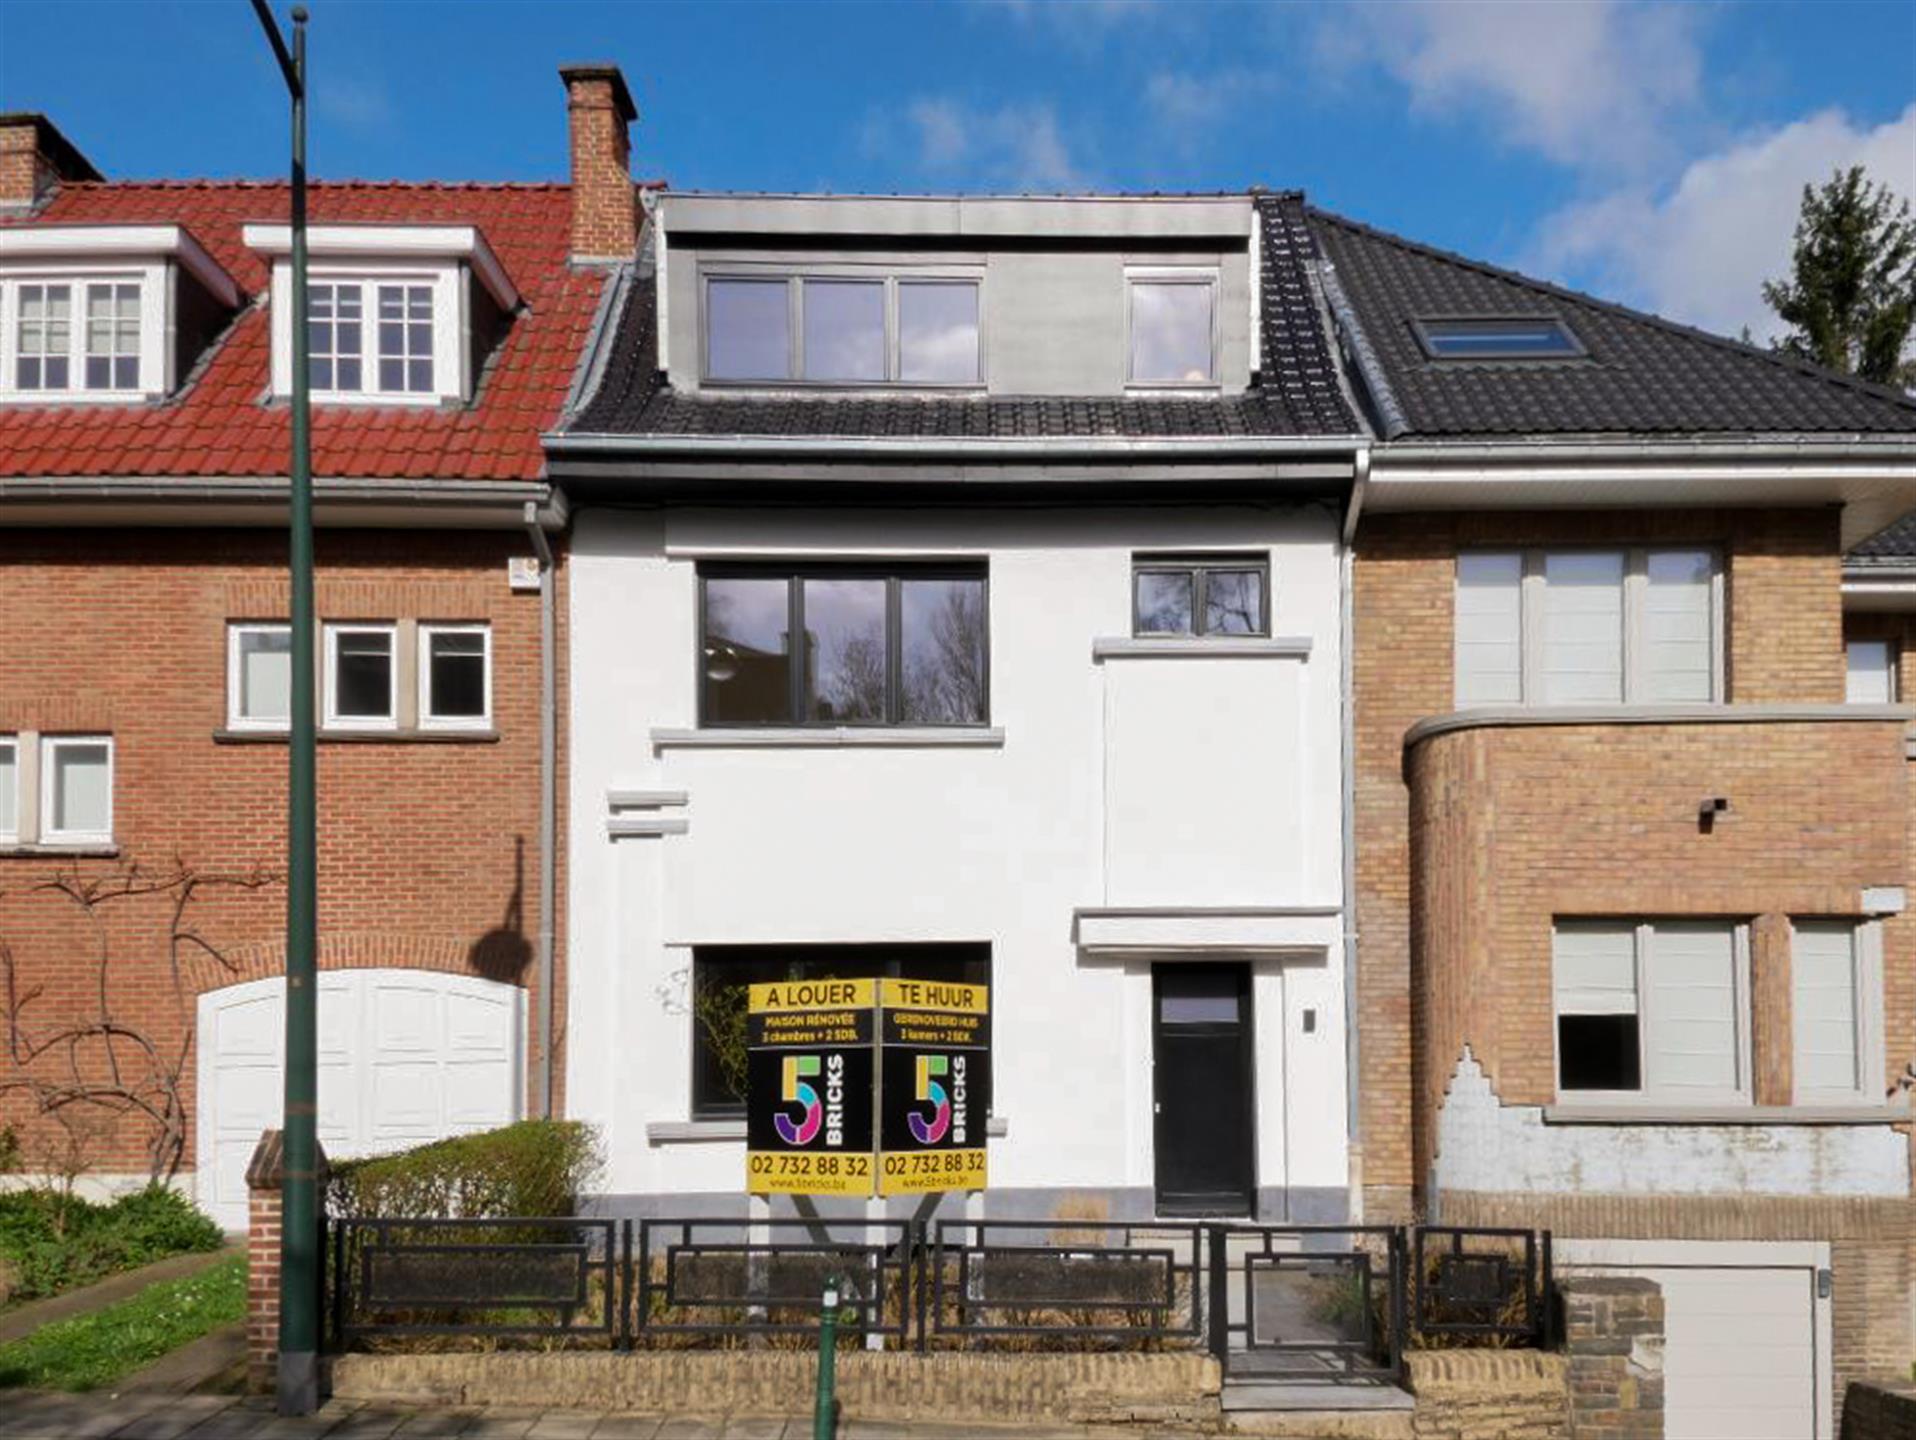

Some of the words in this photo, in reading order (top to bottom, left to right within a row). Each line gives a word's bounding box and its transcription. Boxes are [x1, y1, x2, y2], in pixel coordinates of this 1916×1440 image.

[767, 988, 780, 1006] A
[787, 984, 856, 1005] LOUER
[898, 984, 920, 1005] TE
[926, 986, 973, 1007] HUUR
[765, 1014, 804, 1027] MAISON
[773, 1055, 822, 1146] 5
[826, 1054, 844, 1146] BRICKS
[907, 1054, 951, 1144] 5
[952, 1055, 966, 1144] BRICKS
[751, 1155, 773, 1174] 02
[779, 1156, 810, 1175] 732
[817, 1156, 839, 1176] 88
[845, 1156, 868, 1176] 32
[885, 1156, 906, 1175] 02
[912, 1155, 940, 1174] 732
[944, 1153, 963, 1172] 88
[967, 1151, 985, 1171] 32
